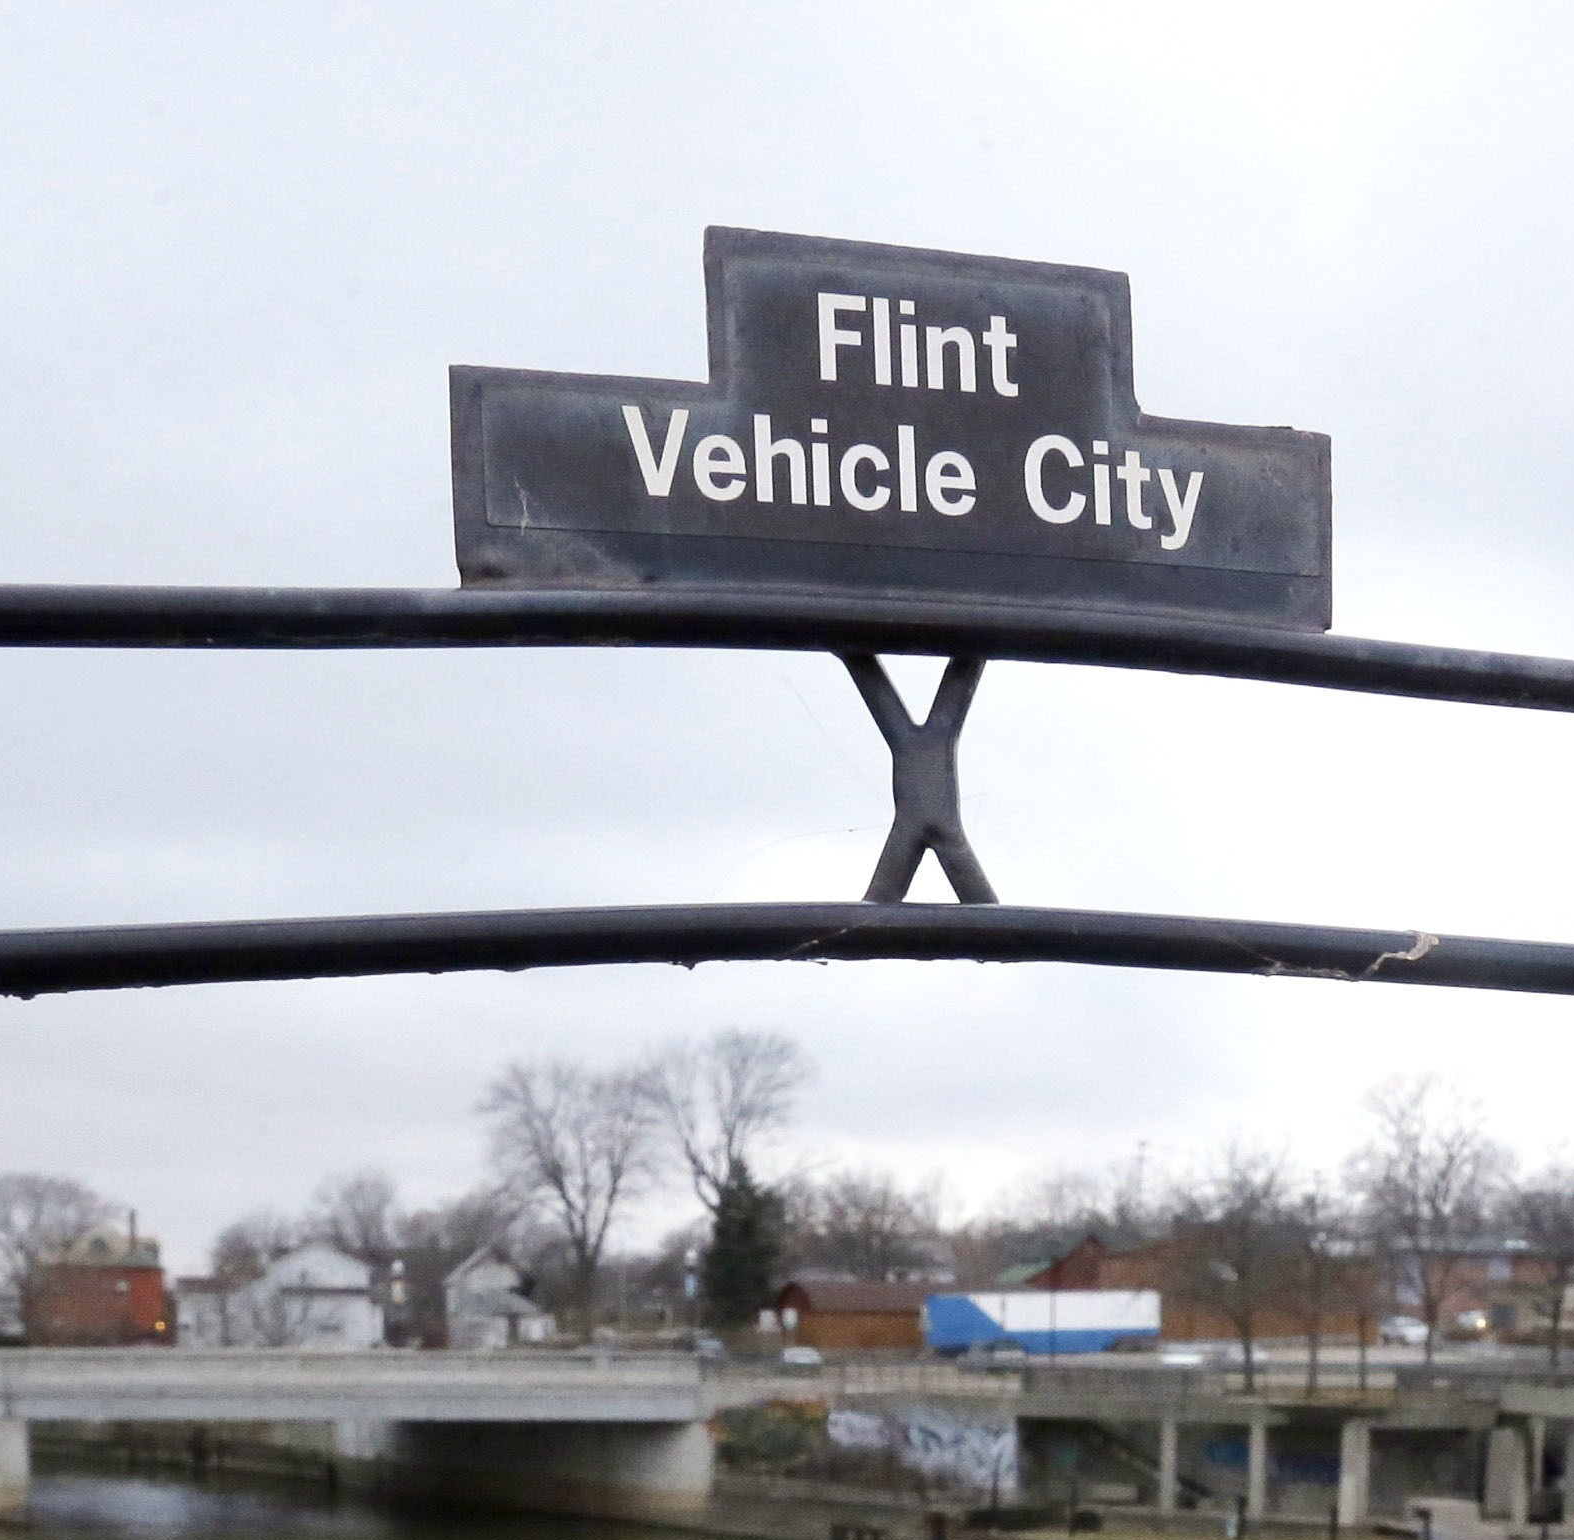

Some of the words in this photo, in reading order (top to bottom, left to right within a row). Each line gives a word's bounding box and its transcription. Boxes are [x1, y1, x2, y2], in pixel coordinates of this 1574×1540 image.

[817, 292, 1019, 398] Flint
[621, 404, 977, 517] Vehicle
[1024, 434, 1205, 551] City
